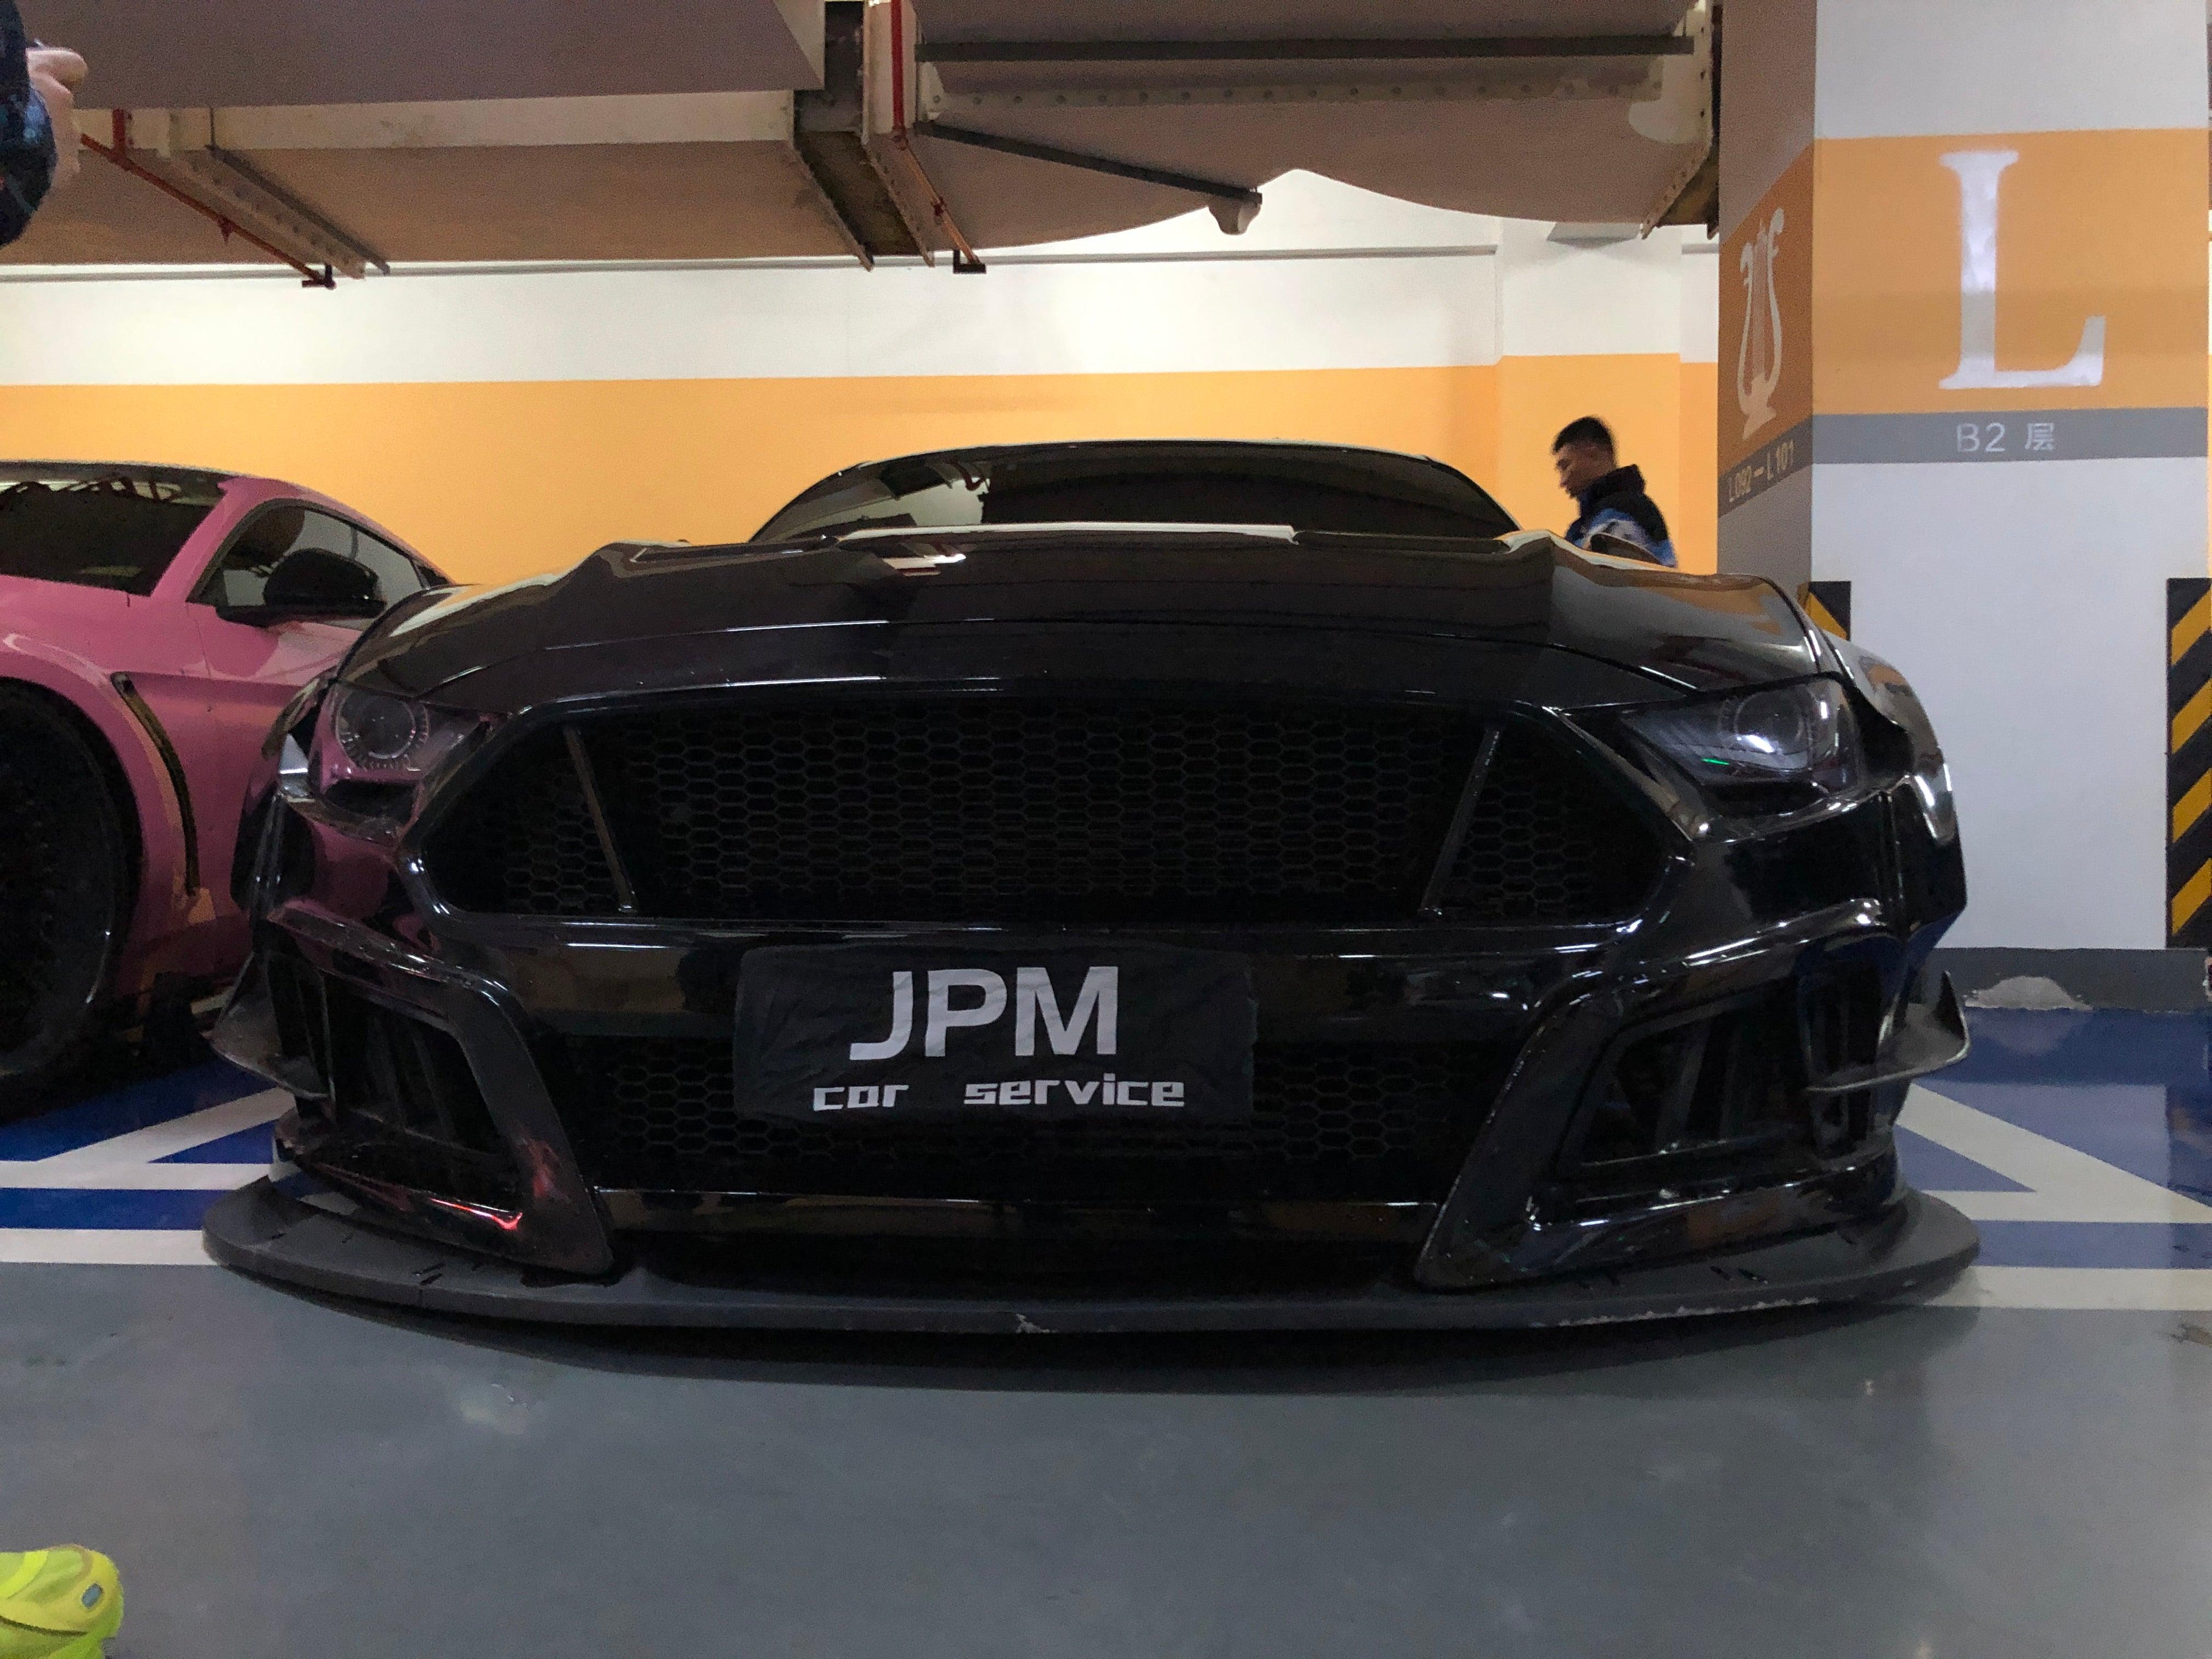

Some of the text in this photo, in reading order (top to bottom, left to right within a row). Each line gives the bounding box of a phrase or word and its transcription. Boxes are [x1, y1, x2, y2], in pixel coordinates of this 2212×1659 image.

[1939, 149, 2106, 390] L
[1956, 422, 2055, 452] B2 层
[850, 966, 1118, 1060] JPM
[812, 1073, 1184, 1111] car service
